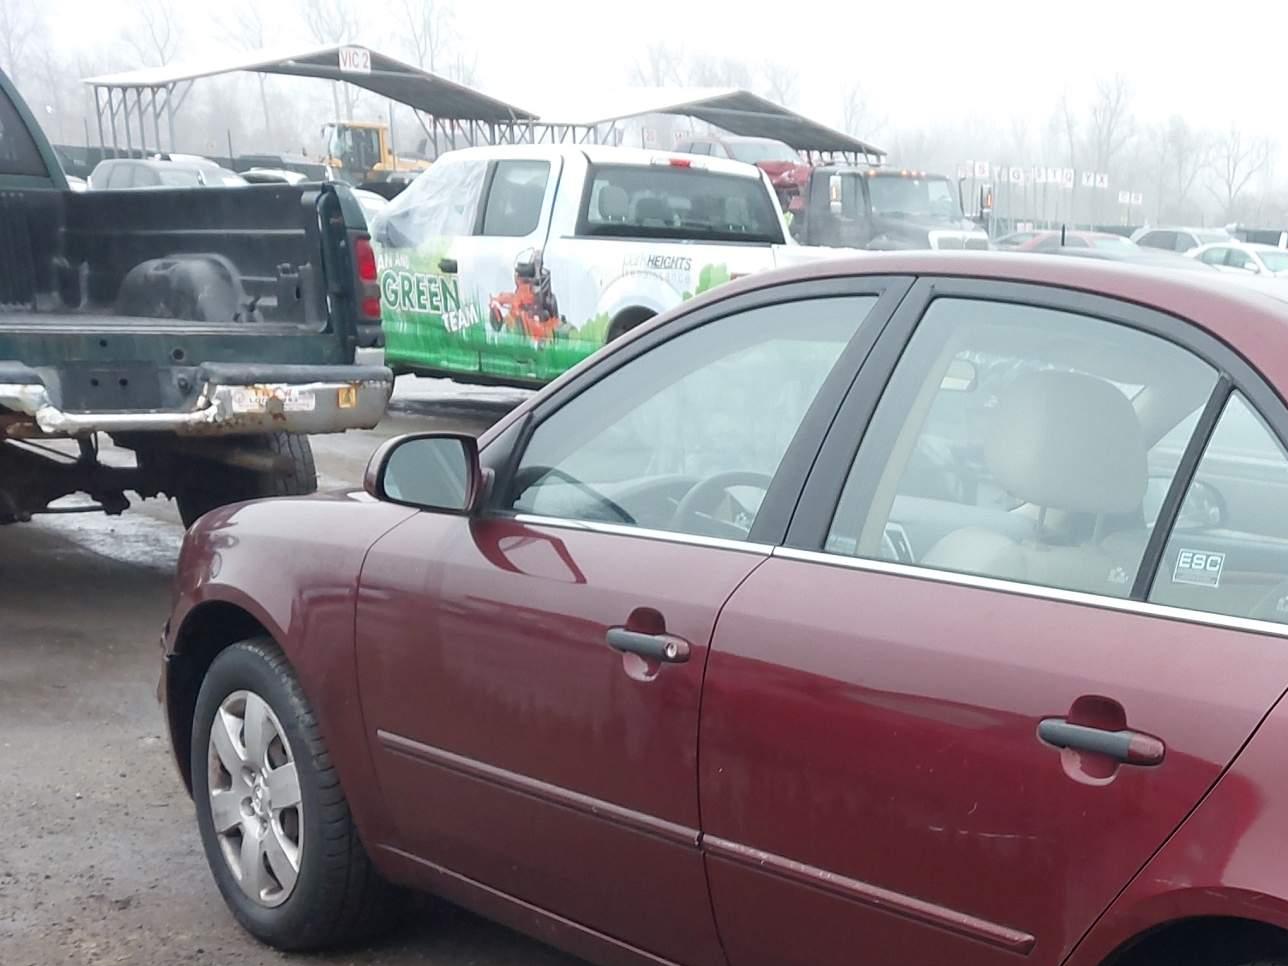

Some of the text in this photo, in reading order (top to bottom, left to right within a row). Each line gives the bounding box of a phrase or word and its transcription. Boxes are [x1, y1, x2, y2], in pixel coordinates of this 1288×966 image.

[340, 49, 369, 69] VIC 2
[647, 254, 692, 271] HEIGHTS
[382, 269, 461, 314] GREEN
[441, 304, 479, 333] TEAM
